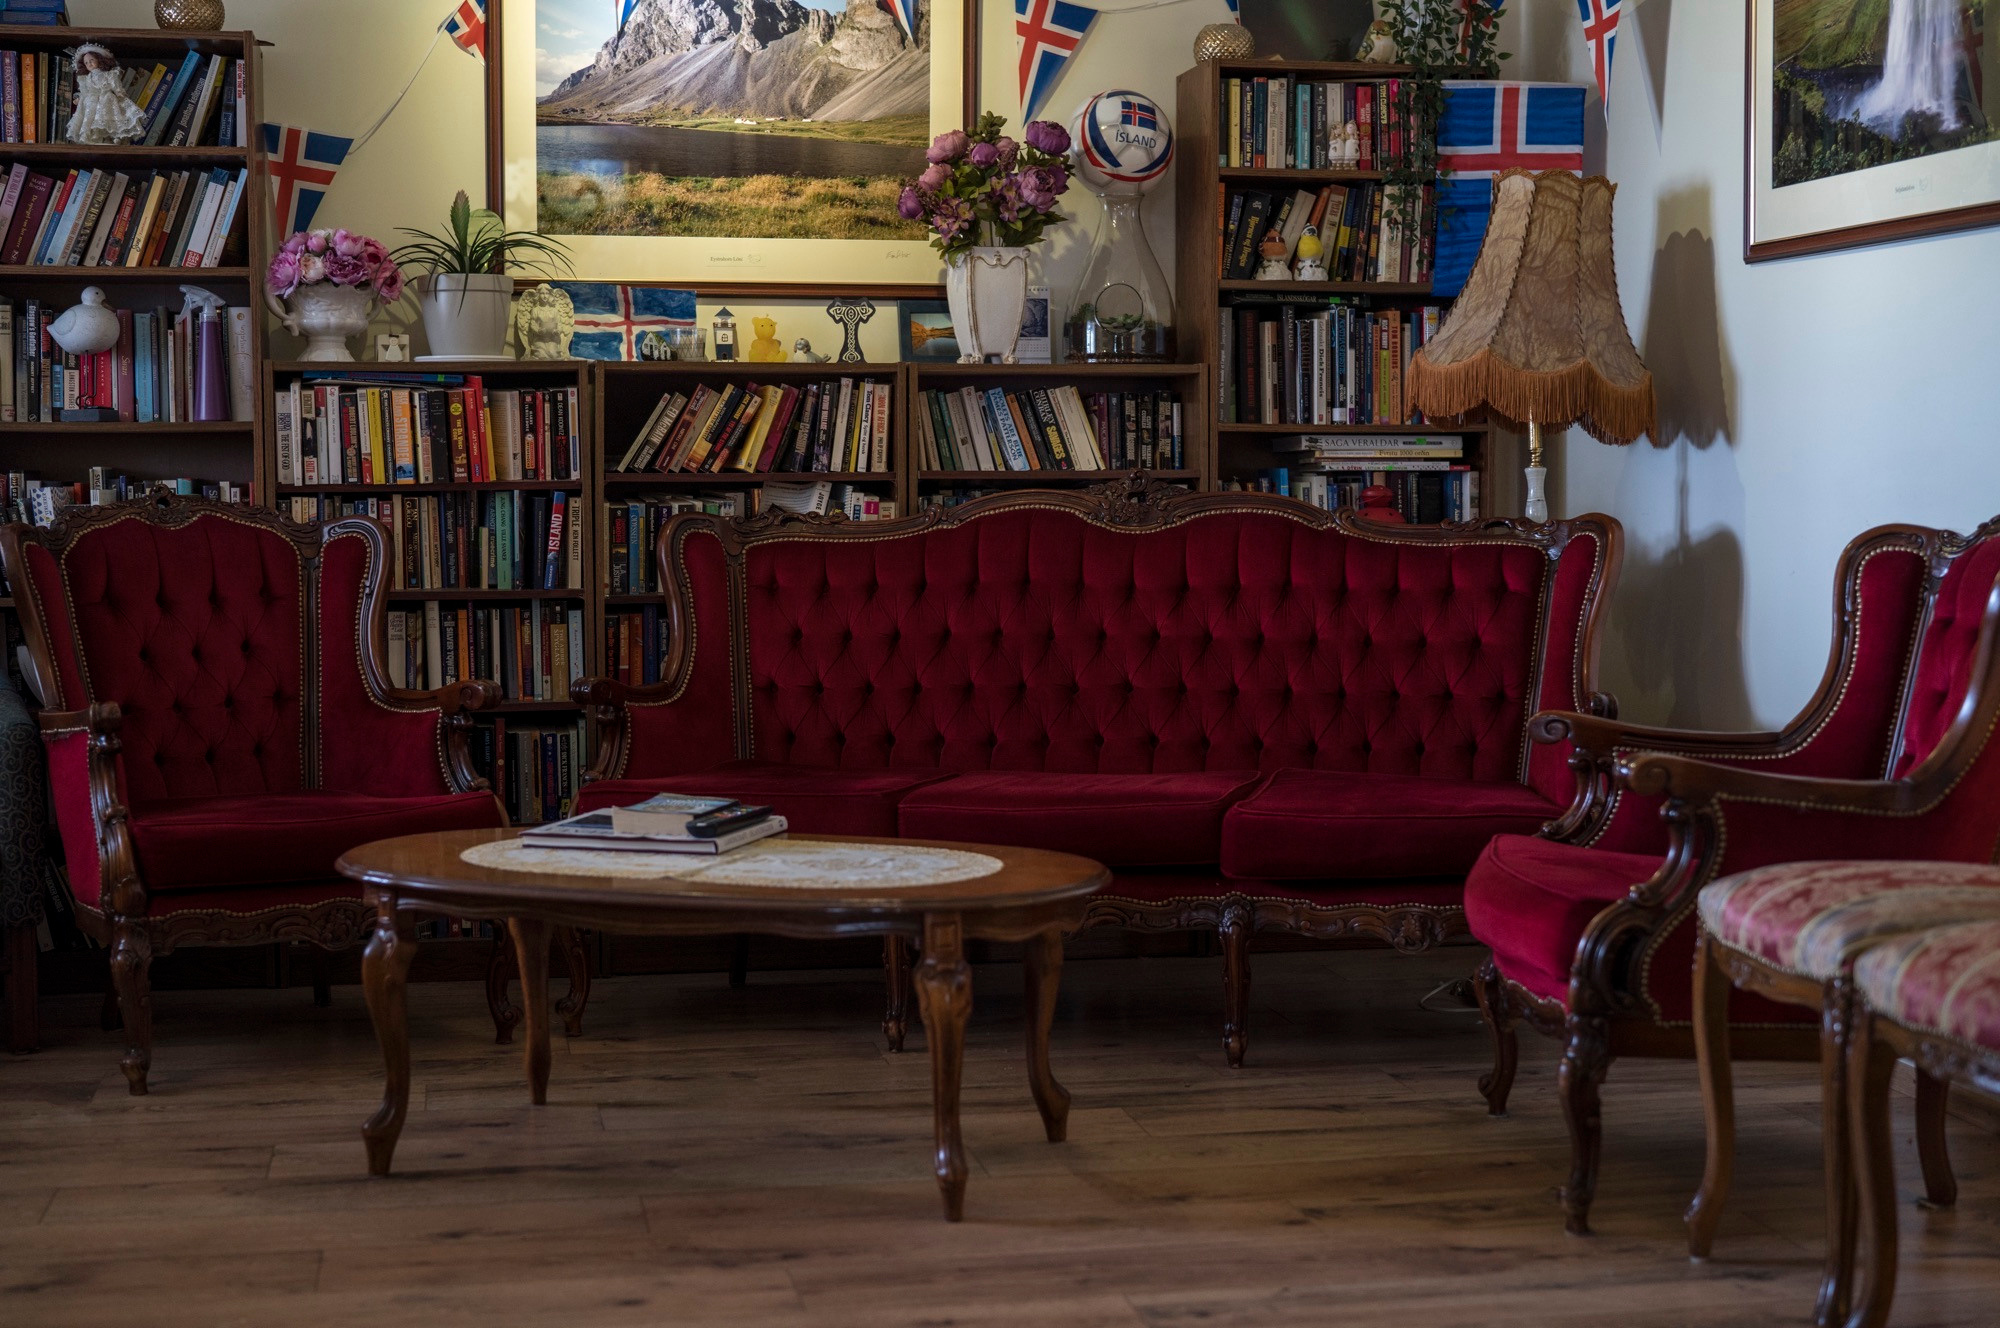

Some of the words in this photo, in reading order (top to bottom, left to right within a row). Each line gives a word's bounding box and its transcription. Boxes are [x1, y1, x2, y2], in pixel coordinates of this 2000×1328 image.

[177, 102, 196, 128] Jonathan
[1115, 129, 1157, 149] ÍSLAND
[88, 173, 98, 192] SUSAN
[1301, 322, 1310, 340] KEN
[1338, 317, 1346, 345] AGATHA
[1390, 325, 1398, 339] TOM
[29, 332, 37, 357] Godfather
[121, 356, 130, 376] Swan
[1301, 341, 1311, 373] FOLLETT
[668, 406, 678, 418] ED
[863, 404, 871, 423] Clancy
[1033, 391, 1046, 423] CONRAN
[1038, 390, 1054, 424] SHIRLEY
[457, 428, 462, 436] DA
[650, 416, 672, 444] McBAIN
[877, 416, 885, 434] AFRICA
[991, 392, 1002, 417] JAMES
[1000, 418, 1018, 461] PATTERSON
[996, 391, 1010, 422] VIOLETS
[1006, 424, 1016, 437] ARE
[1012, 440, 1023, 458] BLUE
[281, 434, 289, 442] THE
[281, 443, 289, 452] FIST
[396, 417, 409, 464] STRANDEN
[1046, 425, 1067, 461] SAVAGES
[1325, 439, 1349, 448] SAGA
[1351, 438, 1399, 447] VERALDAR
[282, 460, 290, 470] GOD
[816, 491, 825, 512] JOYCE
[445, 510, 453, 530] Northern
[572, 506, 580, 527] TRIPLE
[549, 514, 563, 551] ISLAND
[445, 651, 454, 675] TOWER
